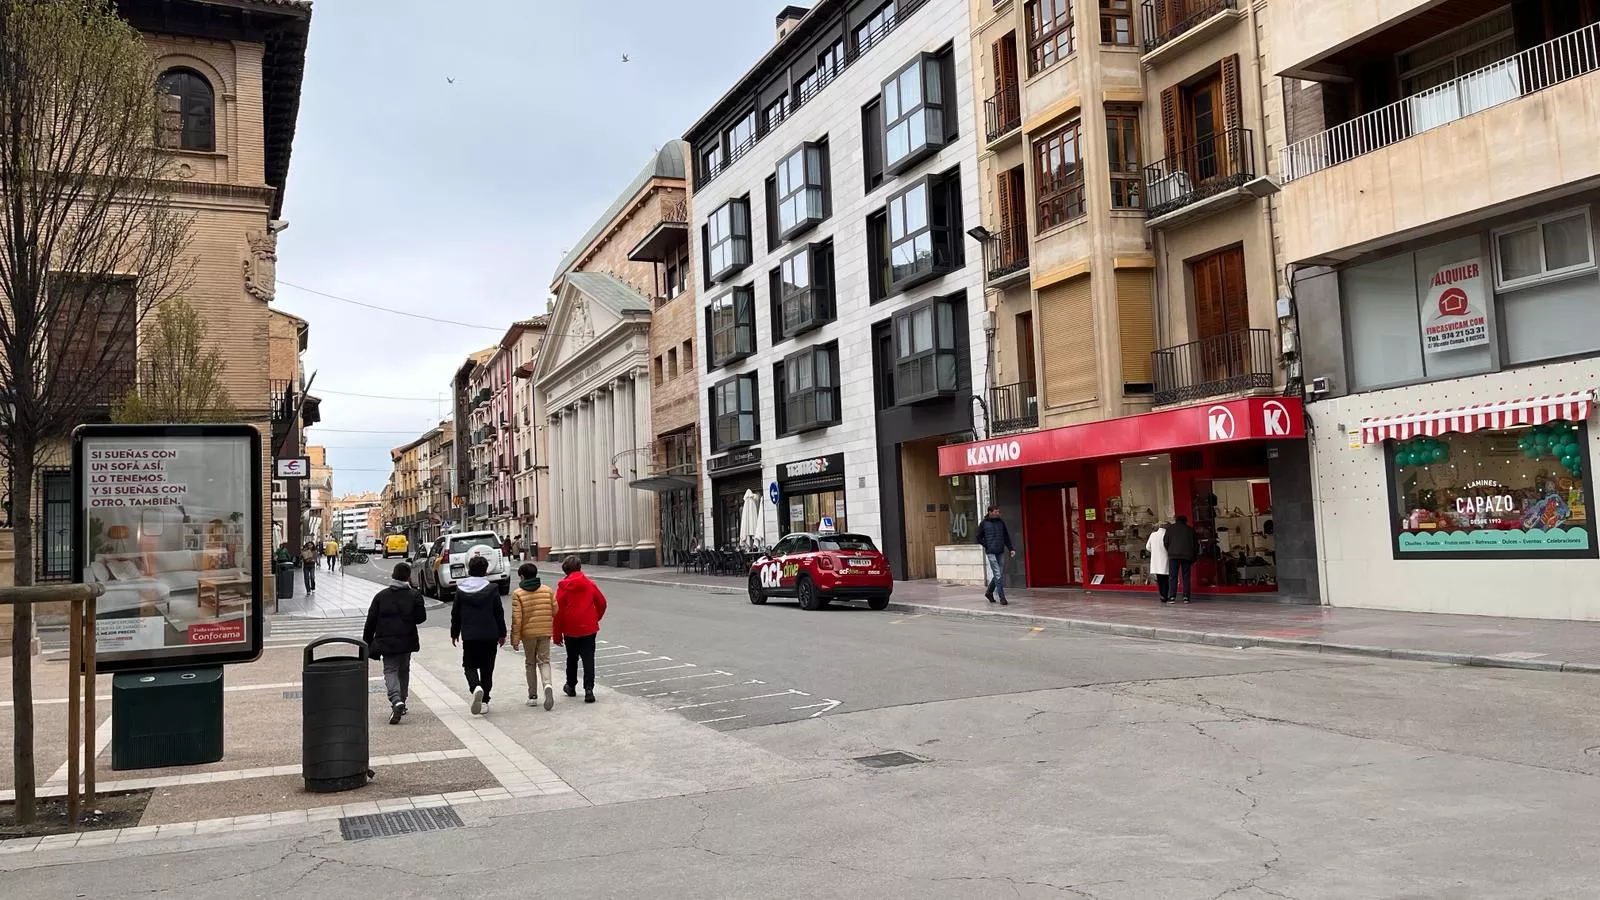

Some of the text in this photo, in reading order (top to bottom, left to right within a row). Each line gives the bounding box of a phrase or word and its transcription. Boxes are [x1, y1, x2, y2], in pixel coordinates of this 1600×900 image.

[1435, 263, 1480, 287] ALQUILER
[1208, 413, 1229, 441] K
[1263, 409, 1285, 436] K
[91, 448, 177, 459] SI SUEÑAS CON
[967, 441, 1021, 466] KAYMO
[91, 460, 164, 471] UN SOFÁ ASÍ,
[91, 474, 167, 483] LO TENEMOS.
[1467, 479, 1498, 489] LAMINES
[91, 484, 187, 495] Y SI SUEÑAS CON
[91, 496, 181, 507] OTRO, TAMBIÉN.
[1456, 494, 1514, 514] CAPAZO
[952, 513, 968, 538] 40
[192, 631, 241, 641] Conforama
